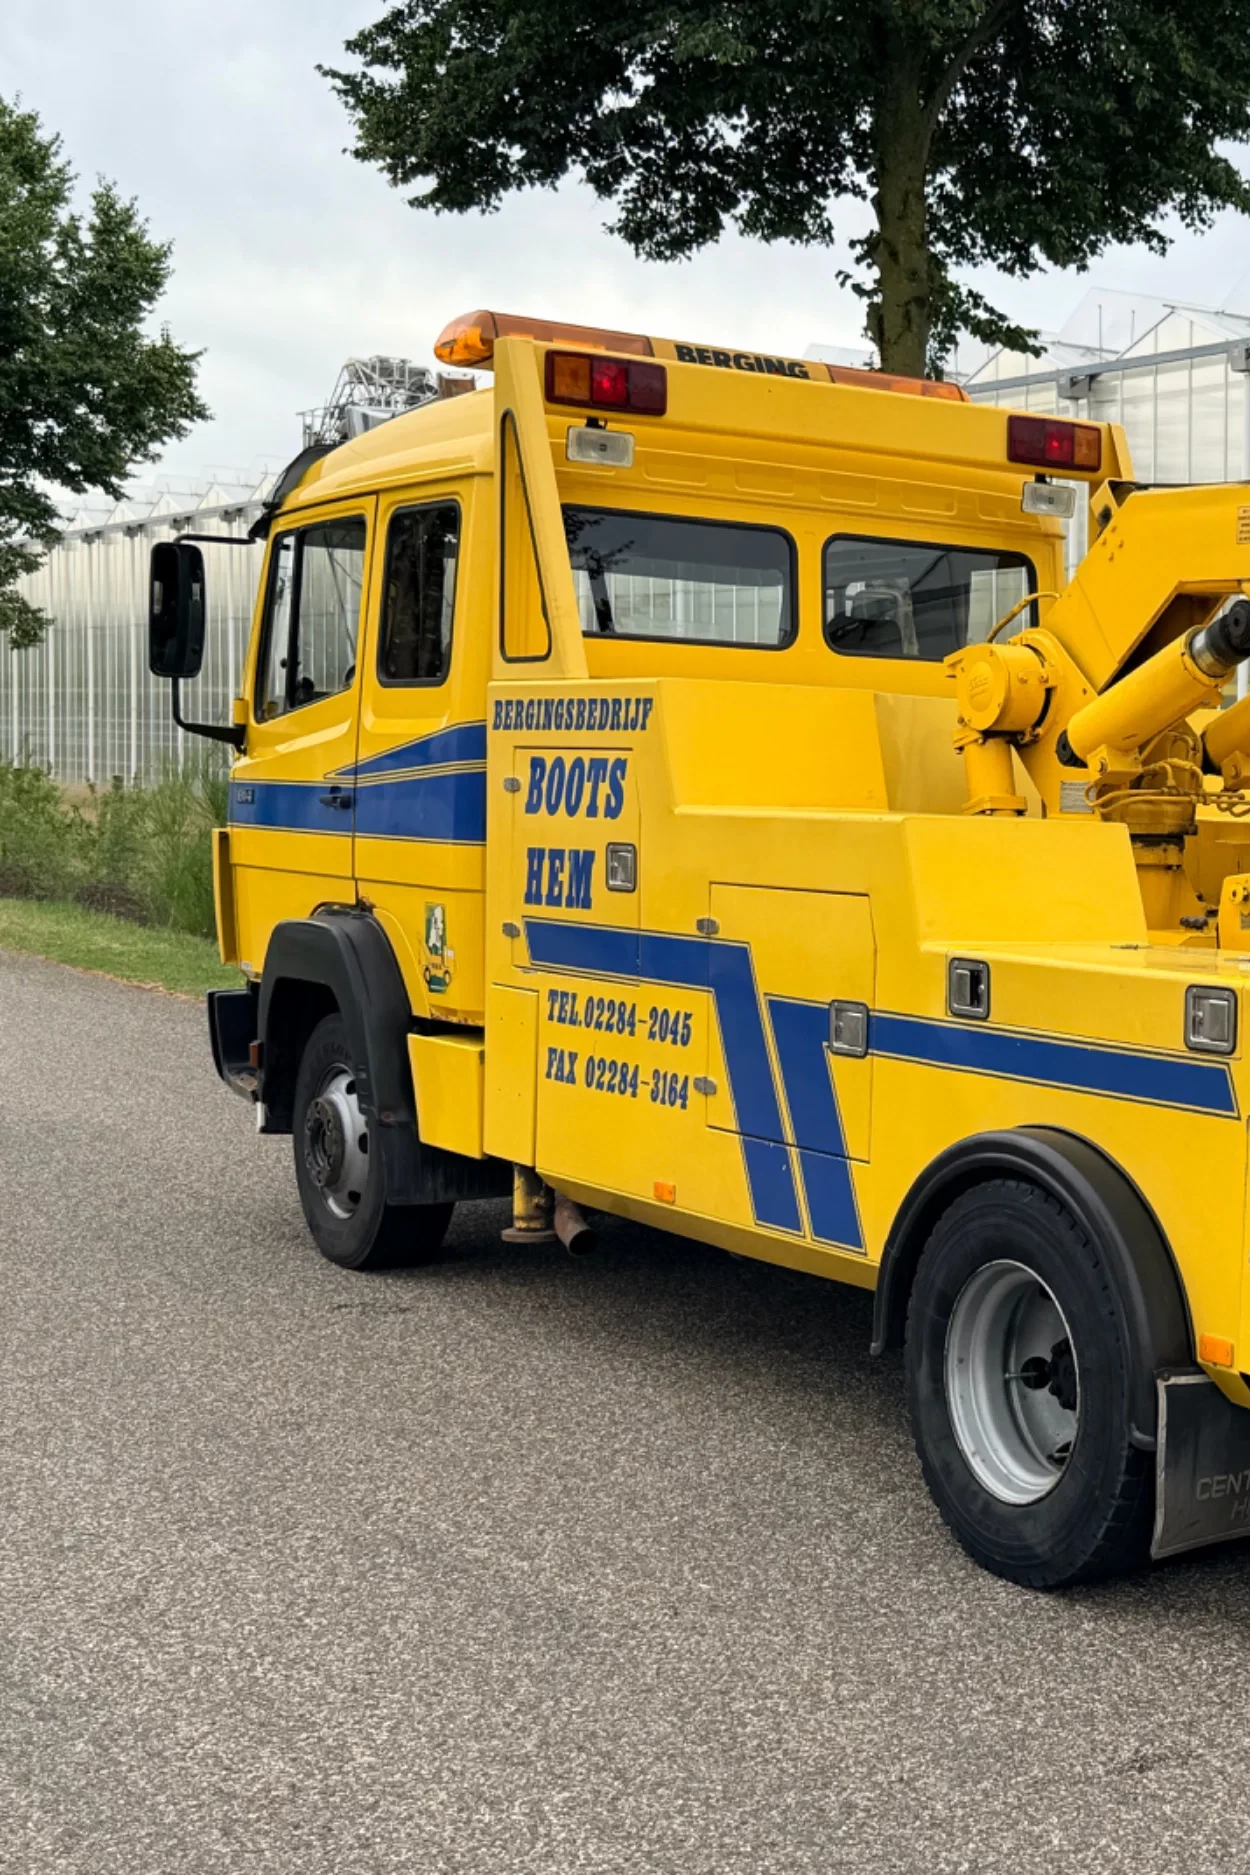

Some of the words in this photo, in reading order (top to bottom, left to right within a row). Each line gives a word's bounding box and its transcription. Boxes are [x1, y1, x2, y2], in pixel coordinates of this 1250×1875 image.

[675, 344, 811, 379] BERGING
[492, 697, 654, 731] BERGINGSBEDRIJF
[525, 756, 628, 820] BOOTS
[524, 847, 596, 909] HEM
[545, 1047, 578, 1085] FAX
[584, 1055, 689, 1111] 02284-3164
